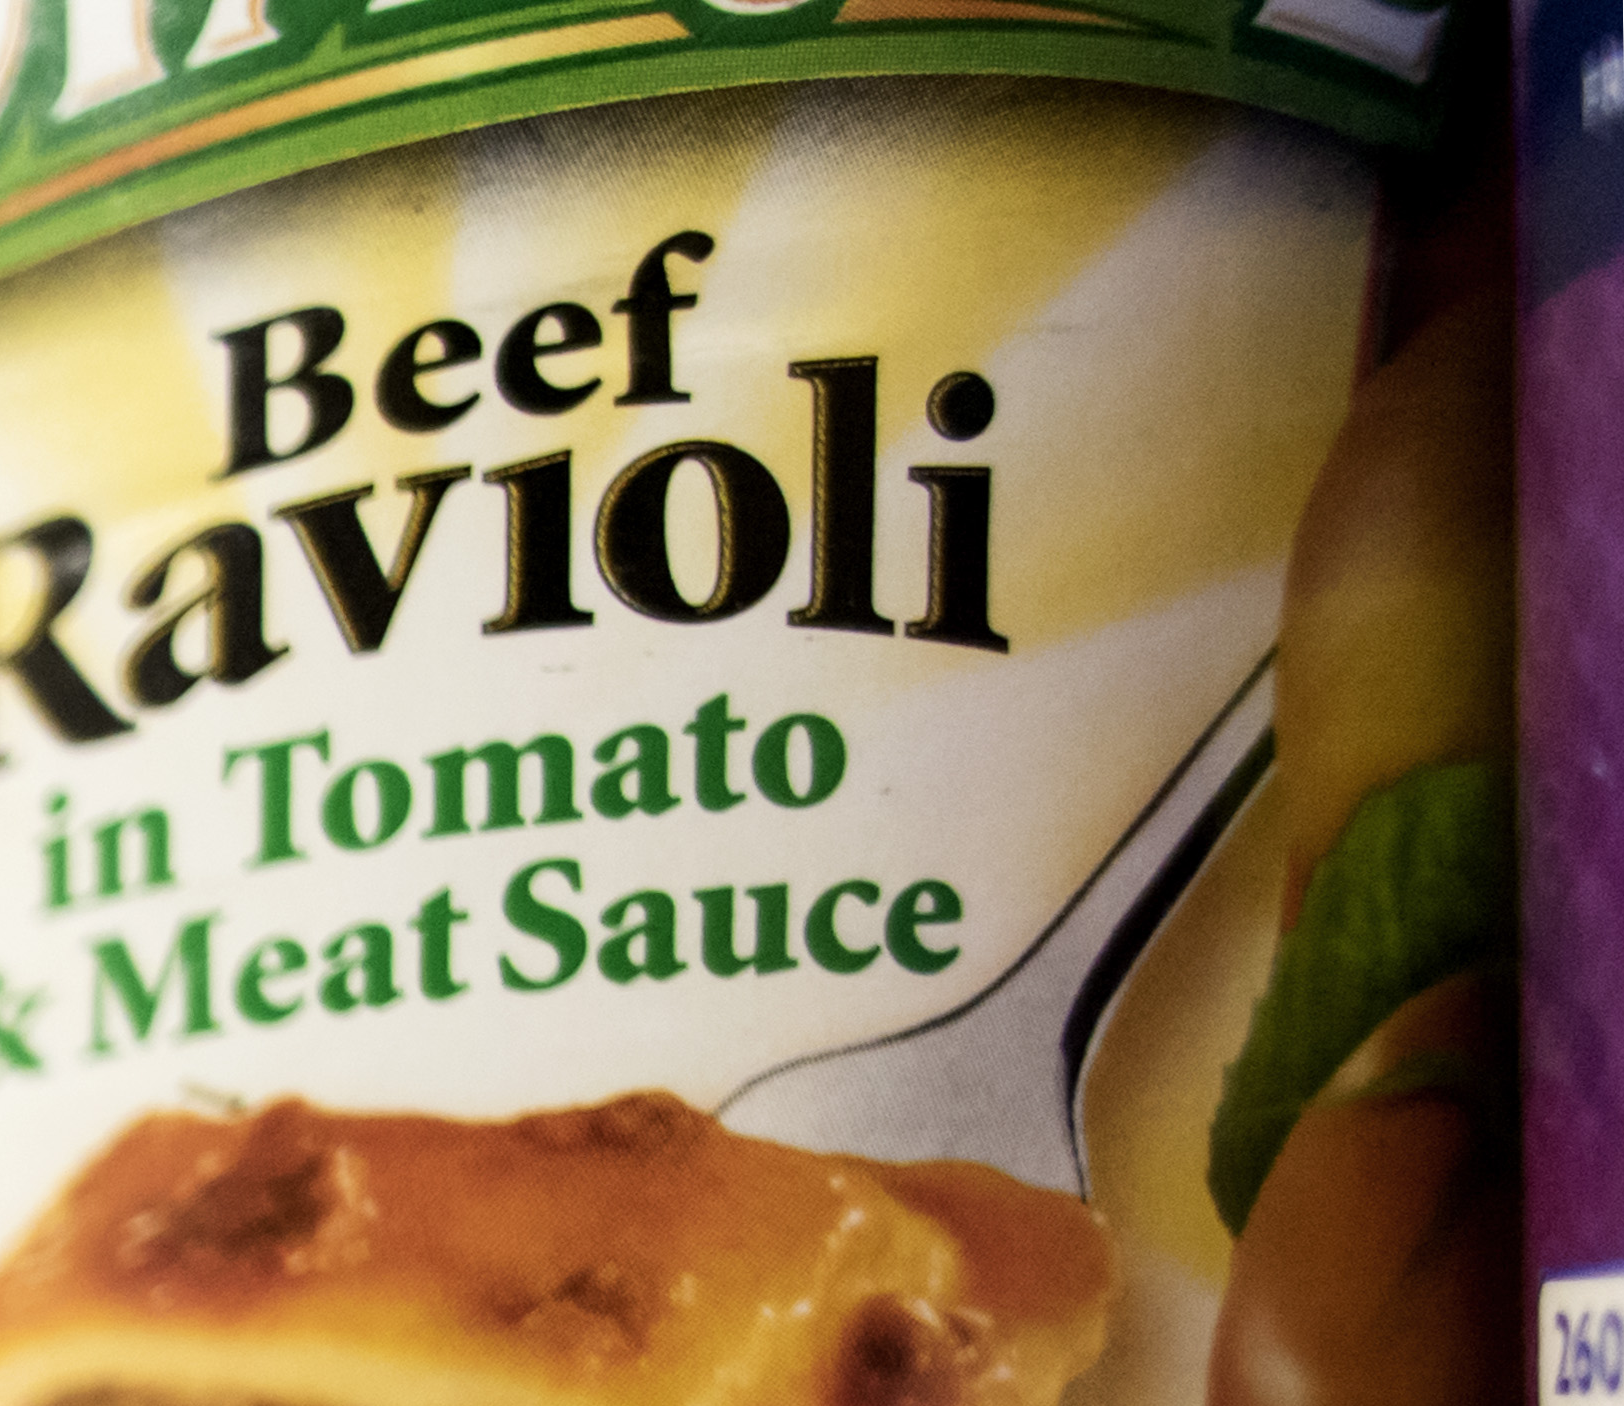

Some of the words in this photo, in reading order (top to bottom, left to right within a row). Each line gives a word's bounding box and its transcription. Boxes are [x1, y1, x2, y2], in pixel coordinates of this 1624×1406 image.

[209, 230, 715, 482] Beef
[38, 789, 180, 920] in
[220, 690, 848, 874] Tomato
[82, 886, 470, 1064] Meat
[496, 857, 965, 994] Sauce
[1555, 1310, 1624, 1396] 260
